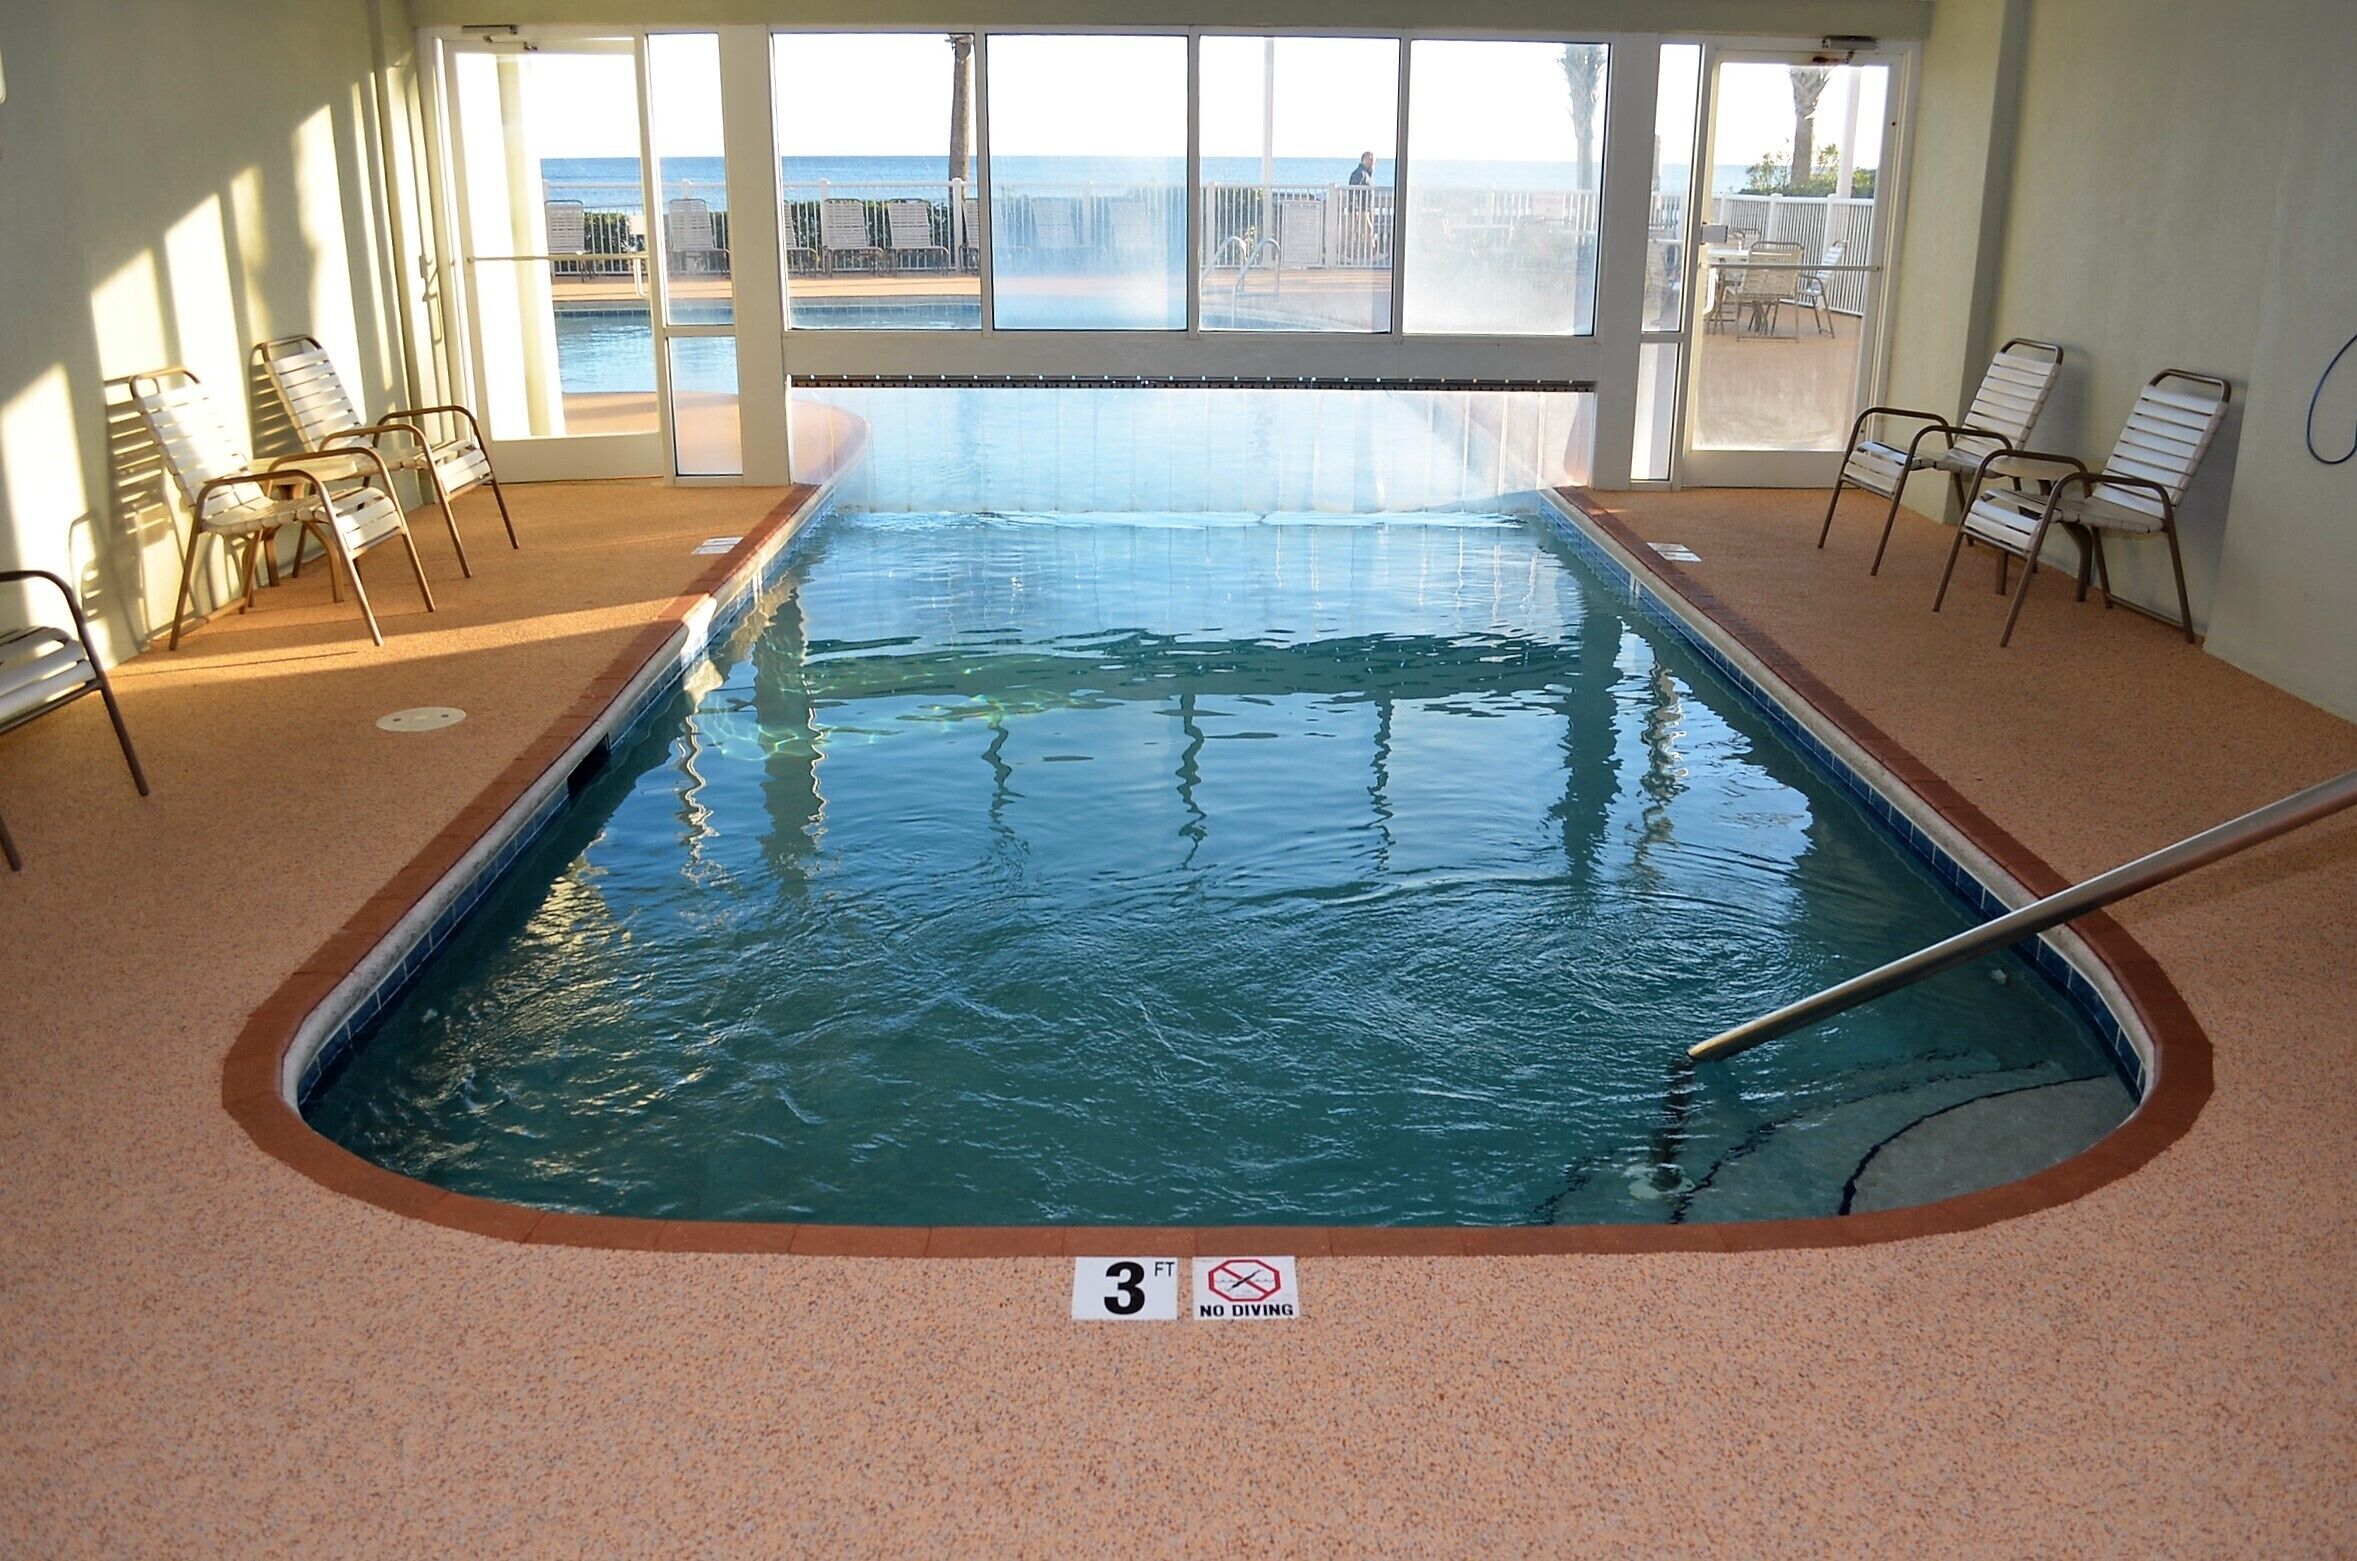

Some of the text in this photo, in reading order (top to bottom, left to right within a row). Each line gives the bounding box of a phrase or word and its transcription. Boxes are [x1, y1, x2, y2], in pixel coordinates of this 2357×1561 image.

[1104, 1261, 1175, 1315] 3 FT
[1200, 1304, 1294, 1317] NO DIVING
